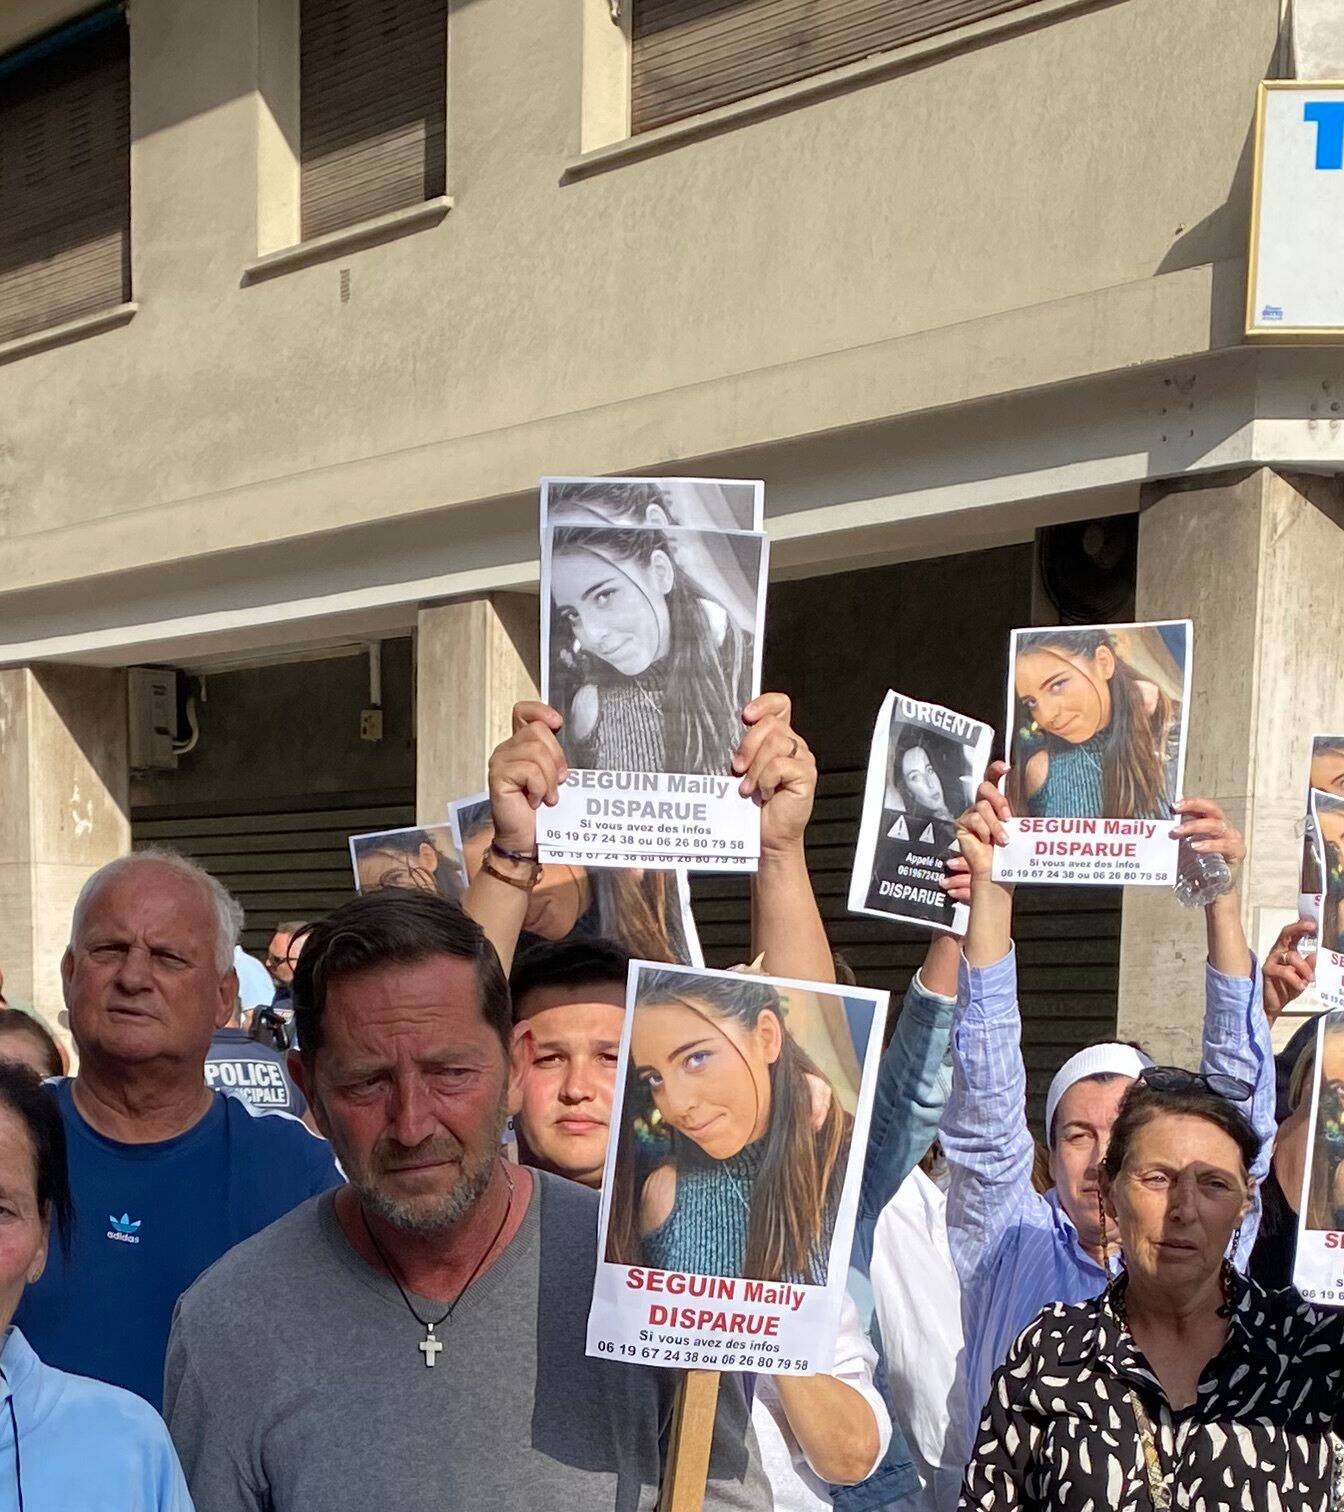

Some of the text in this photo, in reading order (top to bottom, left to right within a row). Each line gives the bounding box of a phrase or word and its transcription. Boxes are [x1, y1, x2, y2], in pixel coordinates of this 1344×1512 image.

[901, 698, 983, 740] URGENT
[566, 771, 729, 799] SEGUIN Maily
[586, 799, 707, 821] DISPARUE
[580, 819, 712, 835] Si vous avez des infos
[1019, 819, 1156, 839] SEGUIN Maily
[547, 830, 744, 849] 06 19 67 24 38 ou 06 26 80 79 58
[1035, 841, 1137, 857] DISPARUE
[1029, 859, 1039, 867] Si
[1094, 860, 1112, 869] des
[1115, 861, 1140, 869] infos
[879, 880, 946, 908] DISPARUE
[204, 1063, 283, 1087] POLICE
[626, 1269, 806, 1311] SEGUIN Maily
[1320, 1290, 1334, 1300] 19
[648, 1305, 781, 1336] DISPARUE
[639, 1330, 780, 1353] Si vous avez des infos
[597, 1341, 809, 1370] 06 19 67 24 38 ou 06 26 80 79 58
